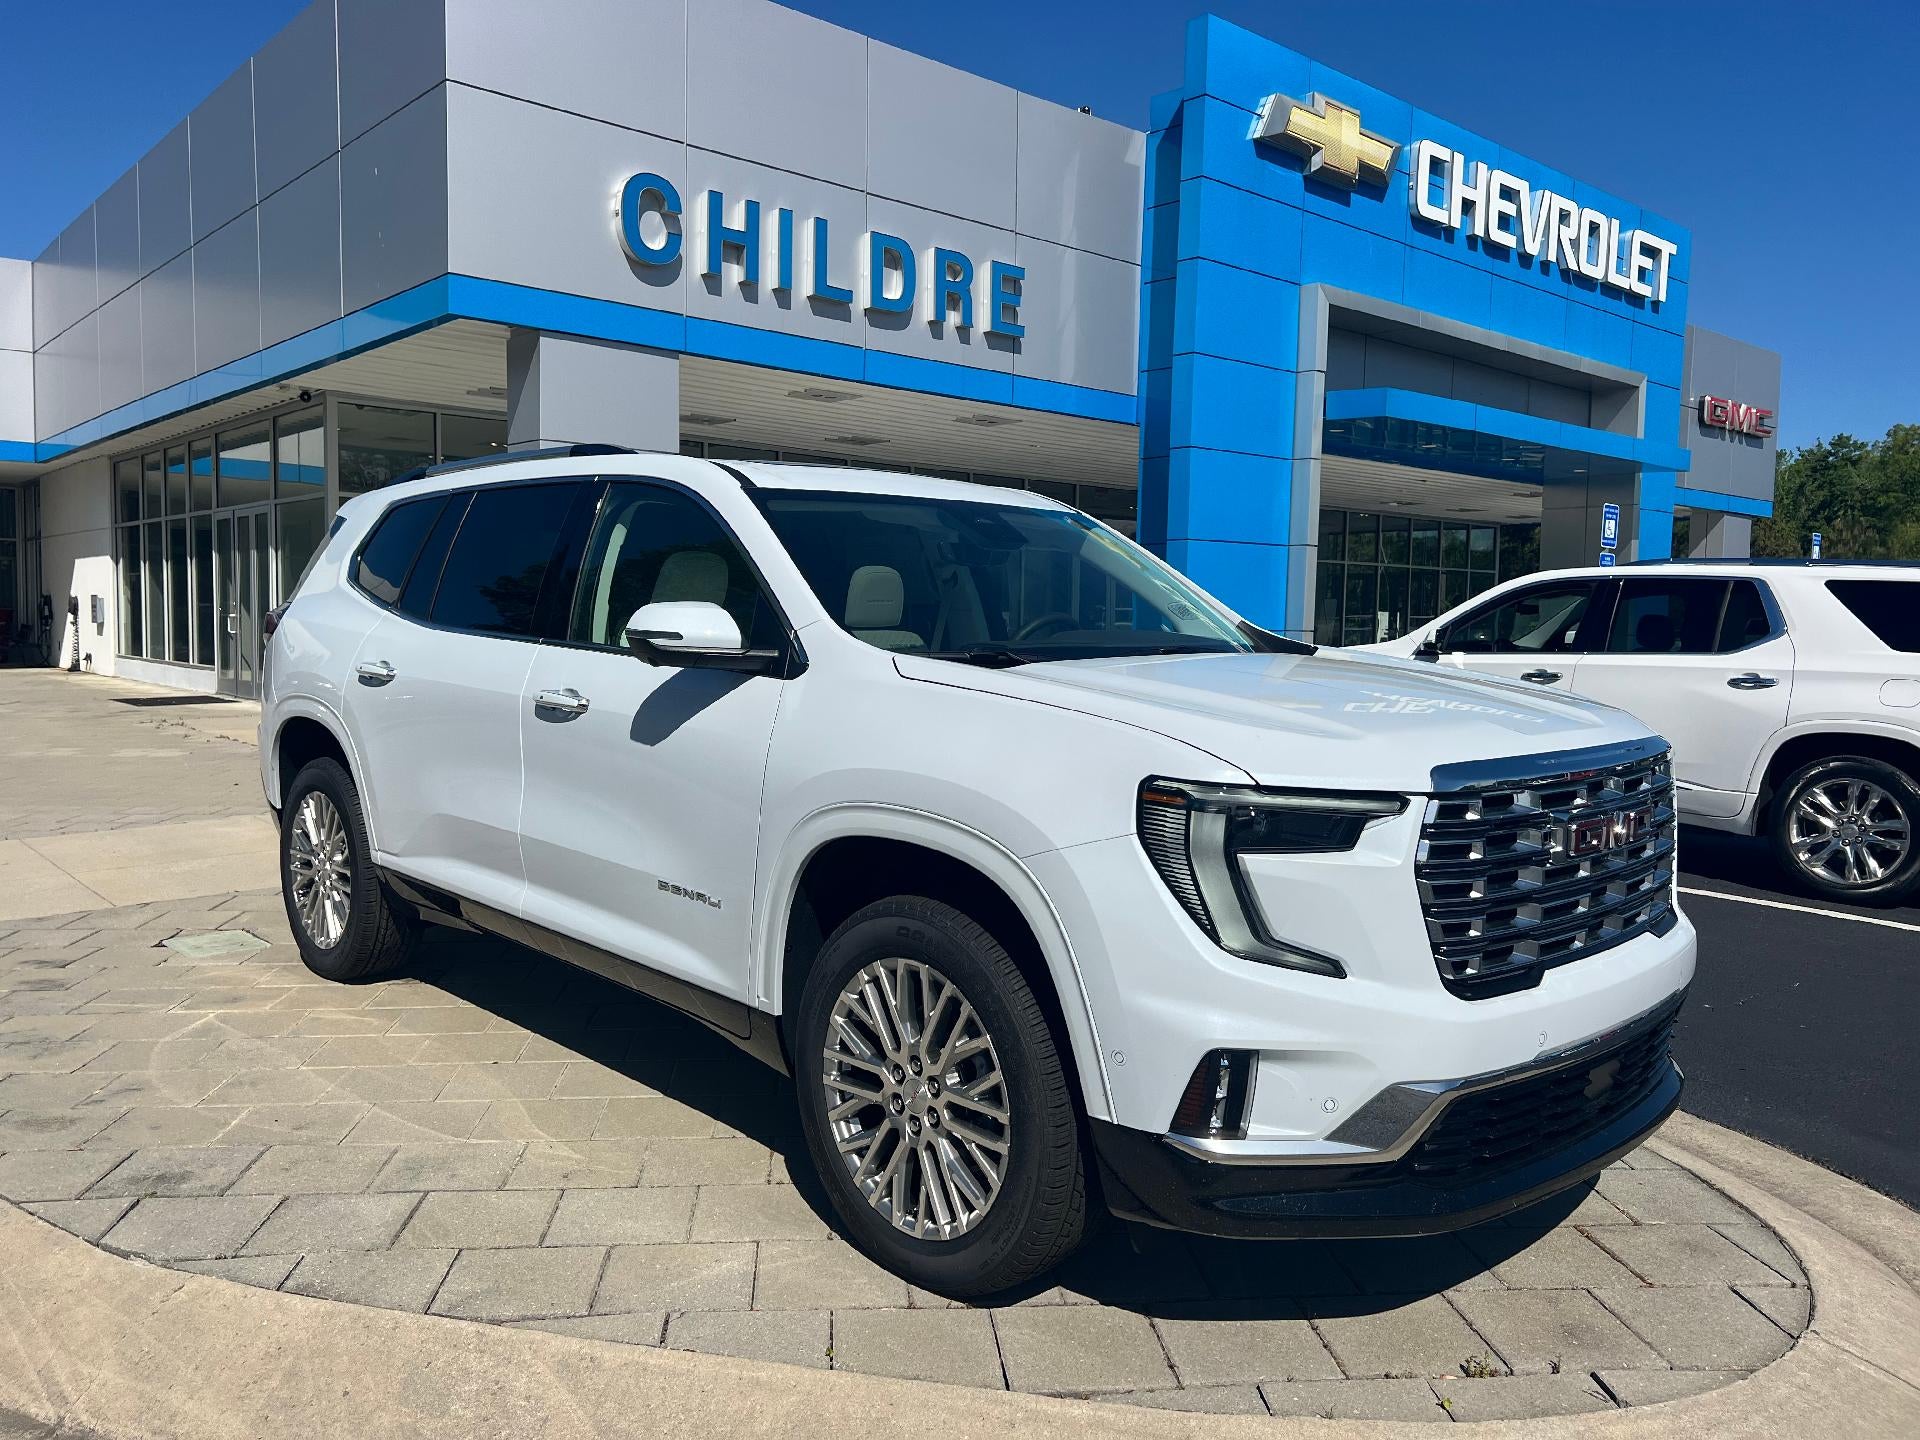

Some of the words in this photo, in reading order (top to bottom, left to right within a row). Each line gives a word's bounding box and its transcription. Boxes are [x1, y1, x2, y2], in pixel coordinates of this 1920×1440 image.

[1410, 139, 1677, 302] CHEVROLET
[615, 172, 1026, 338] CHILDRE
[1704, 395, 1773, 438] GMC
[1570, 806, 1652, 856] GMC
[657, 879, 722, 909] DENALI
